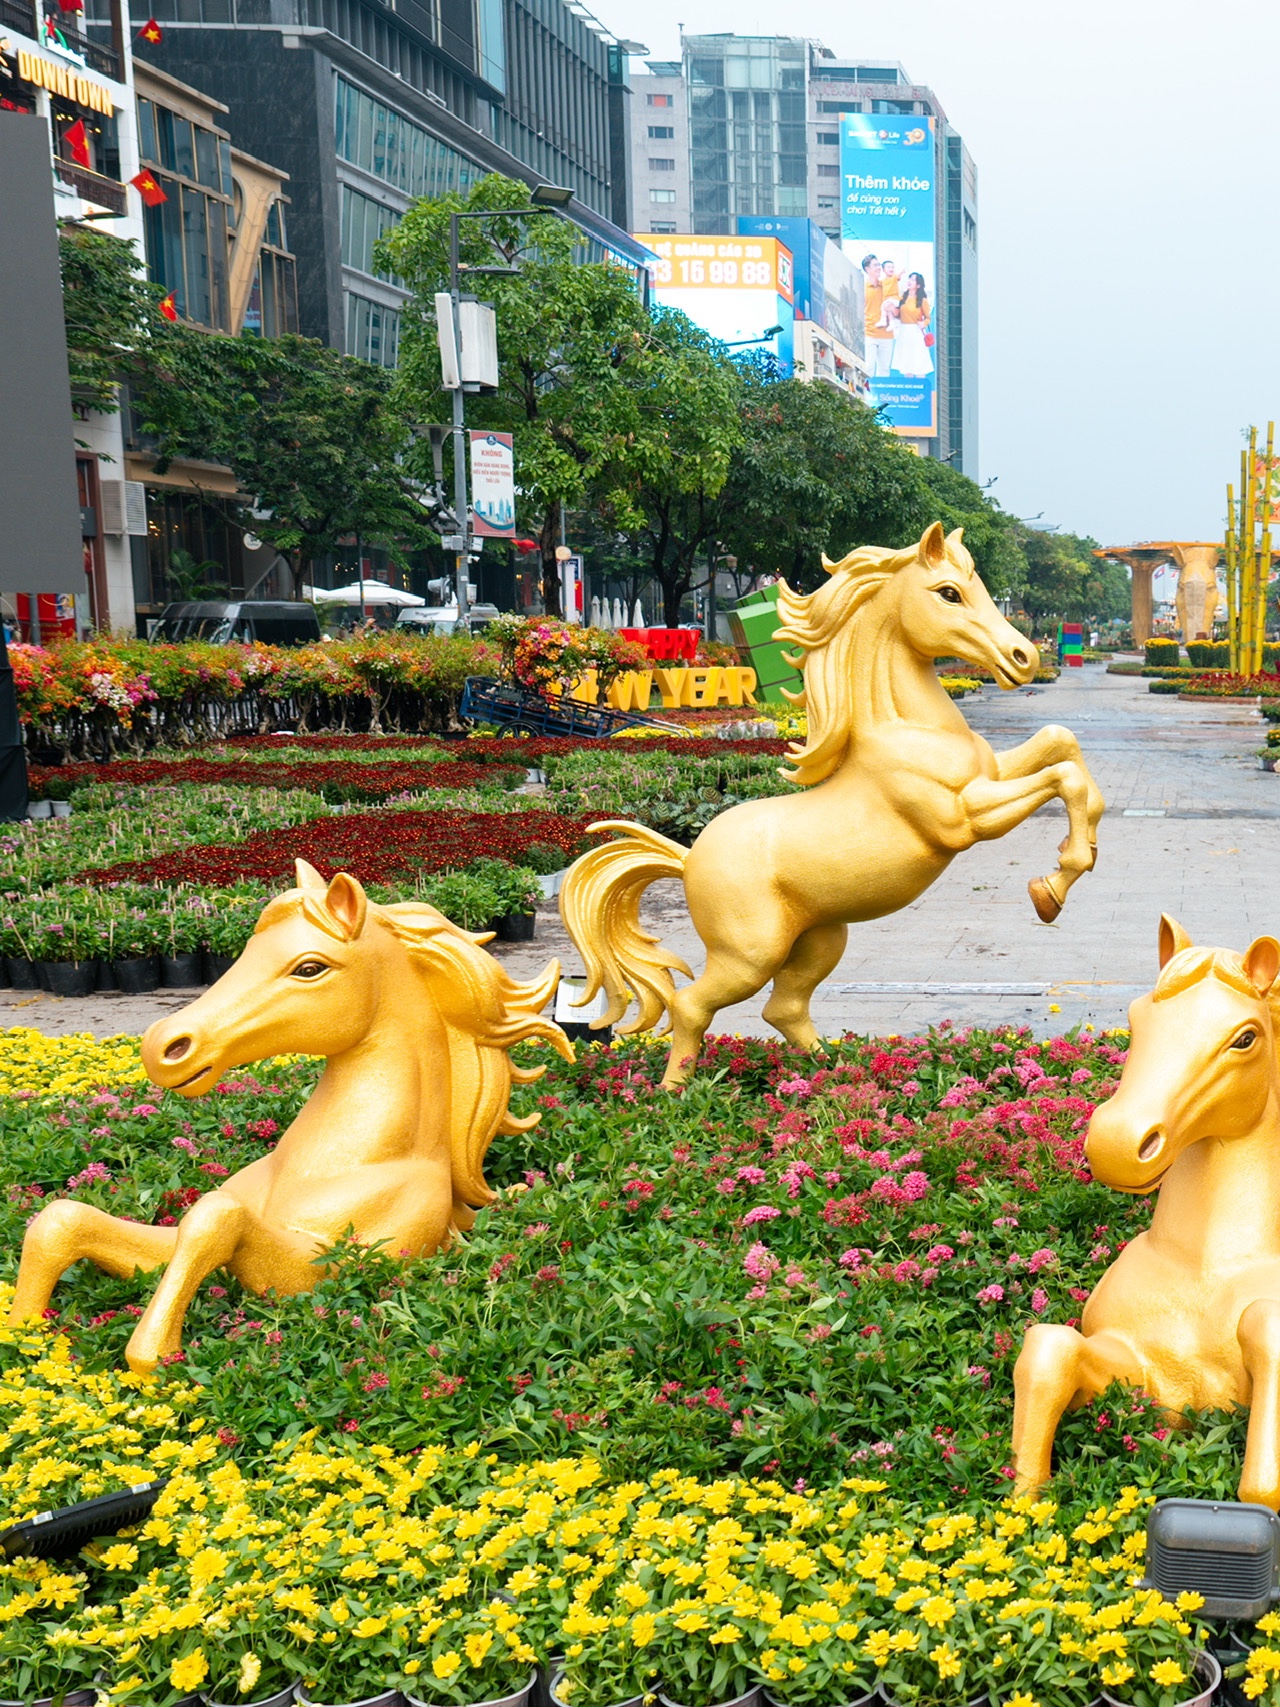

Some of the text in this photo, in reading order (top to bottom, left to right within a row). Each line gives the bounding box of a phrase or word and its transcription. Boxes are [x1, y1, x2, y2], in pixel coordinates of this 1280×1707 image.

[17, 48, 114, 119] DOWNTOWN
[845, 174, 930, 191] Thêm khỏe
[860, 193, 881, 205] cùng
[883, 196, 900, 204] con
[680, 260, 705, 284] 15
[709, 261, 738, 285] 99
[742, 262, 771, 286] 88
[481, 449, 503, 458] KHÔNG
[652, 668, 758, 709] YEAR
